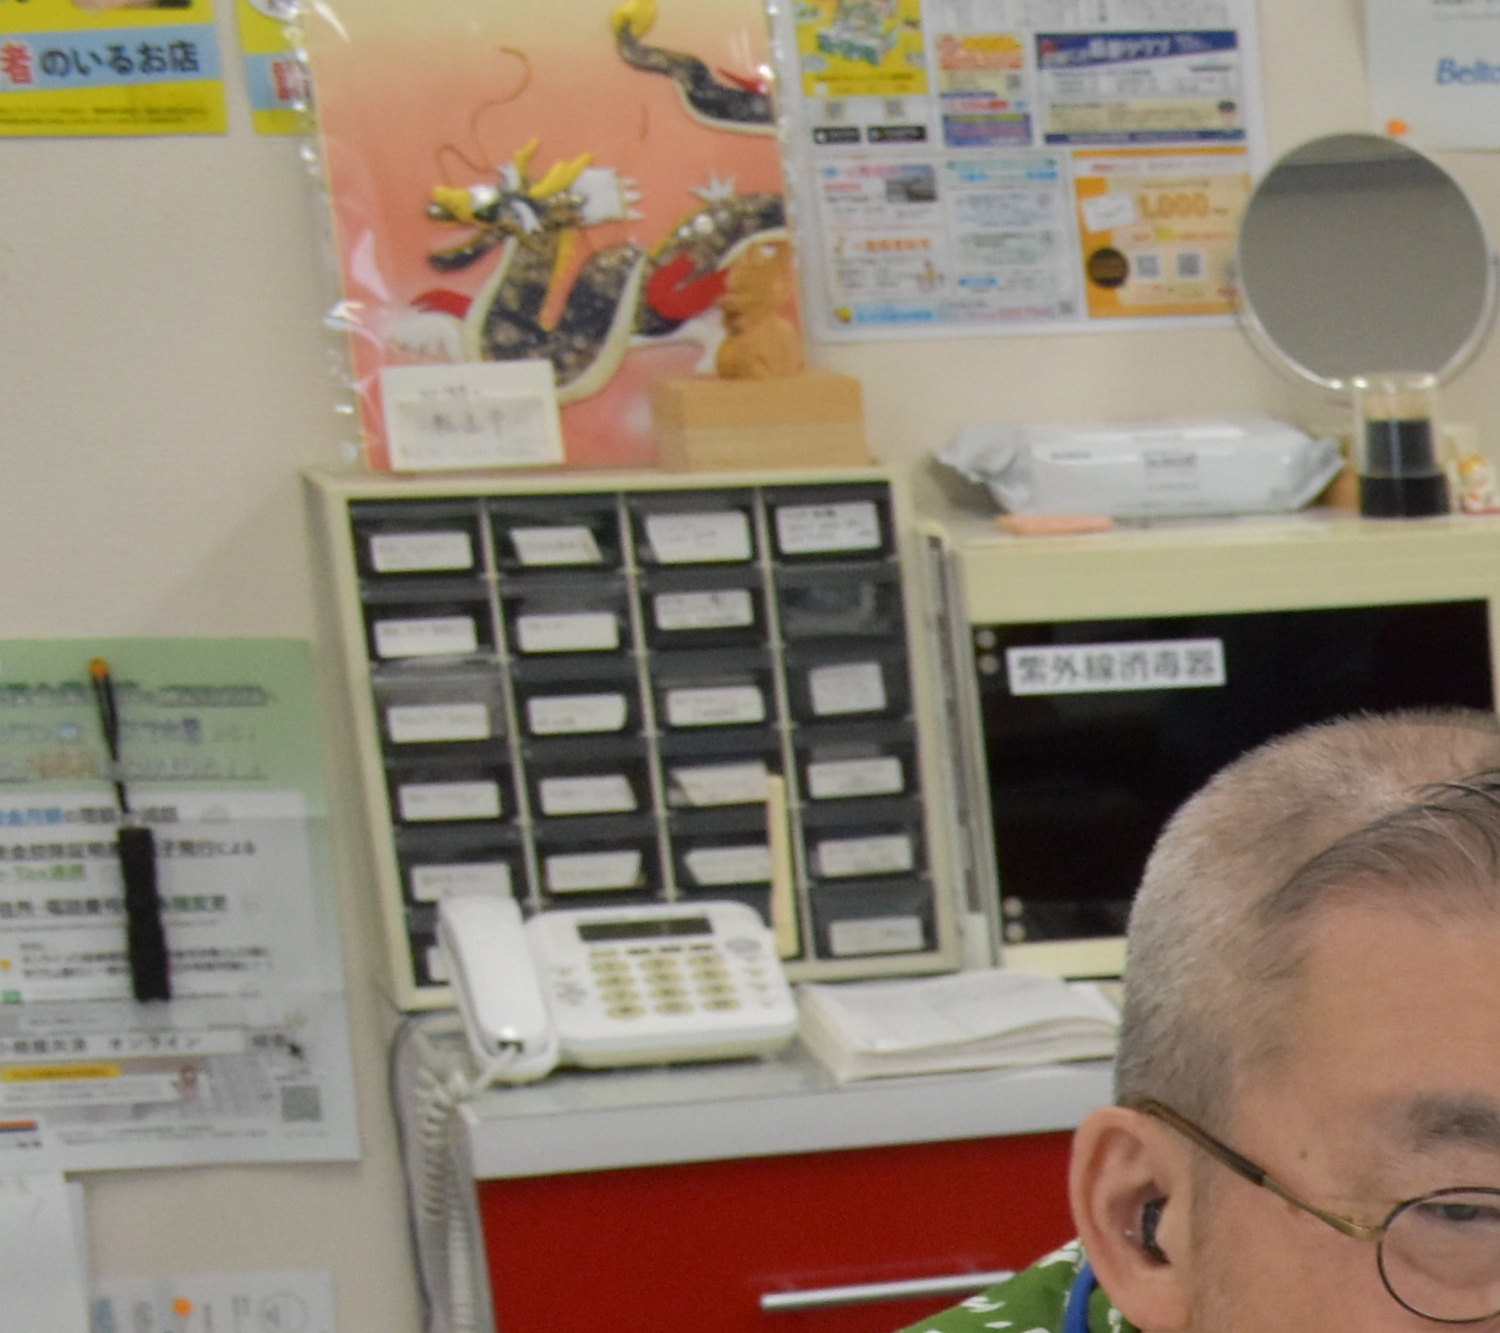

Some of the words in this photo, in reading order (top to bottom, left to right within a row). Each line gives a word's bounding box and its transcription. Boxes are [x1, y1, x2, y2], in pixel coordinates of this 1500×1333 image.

[1016, 647, 1216, 687] 紫外線消毒器
